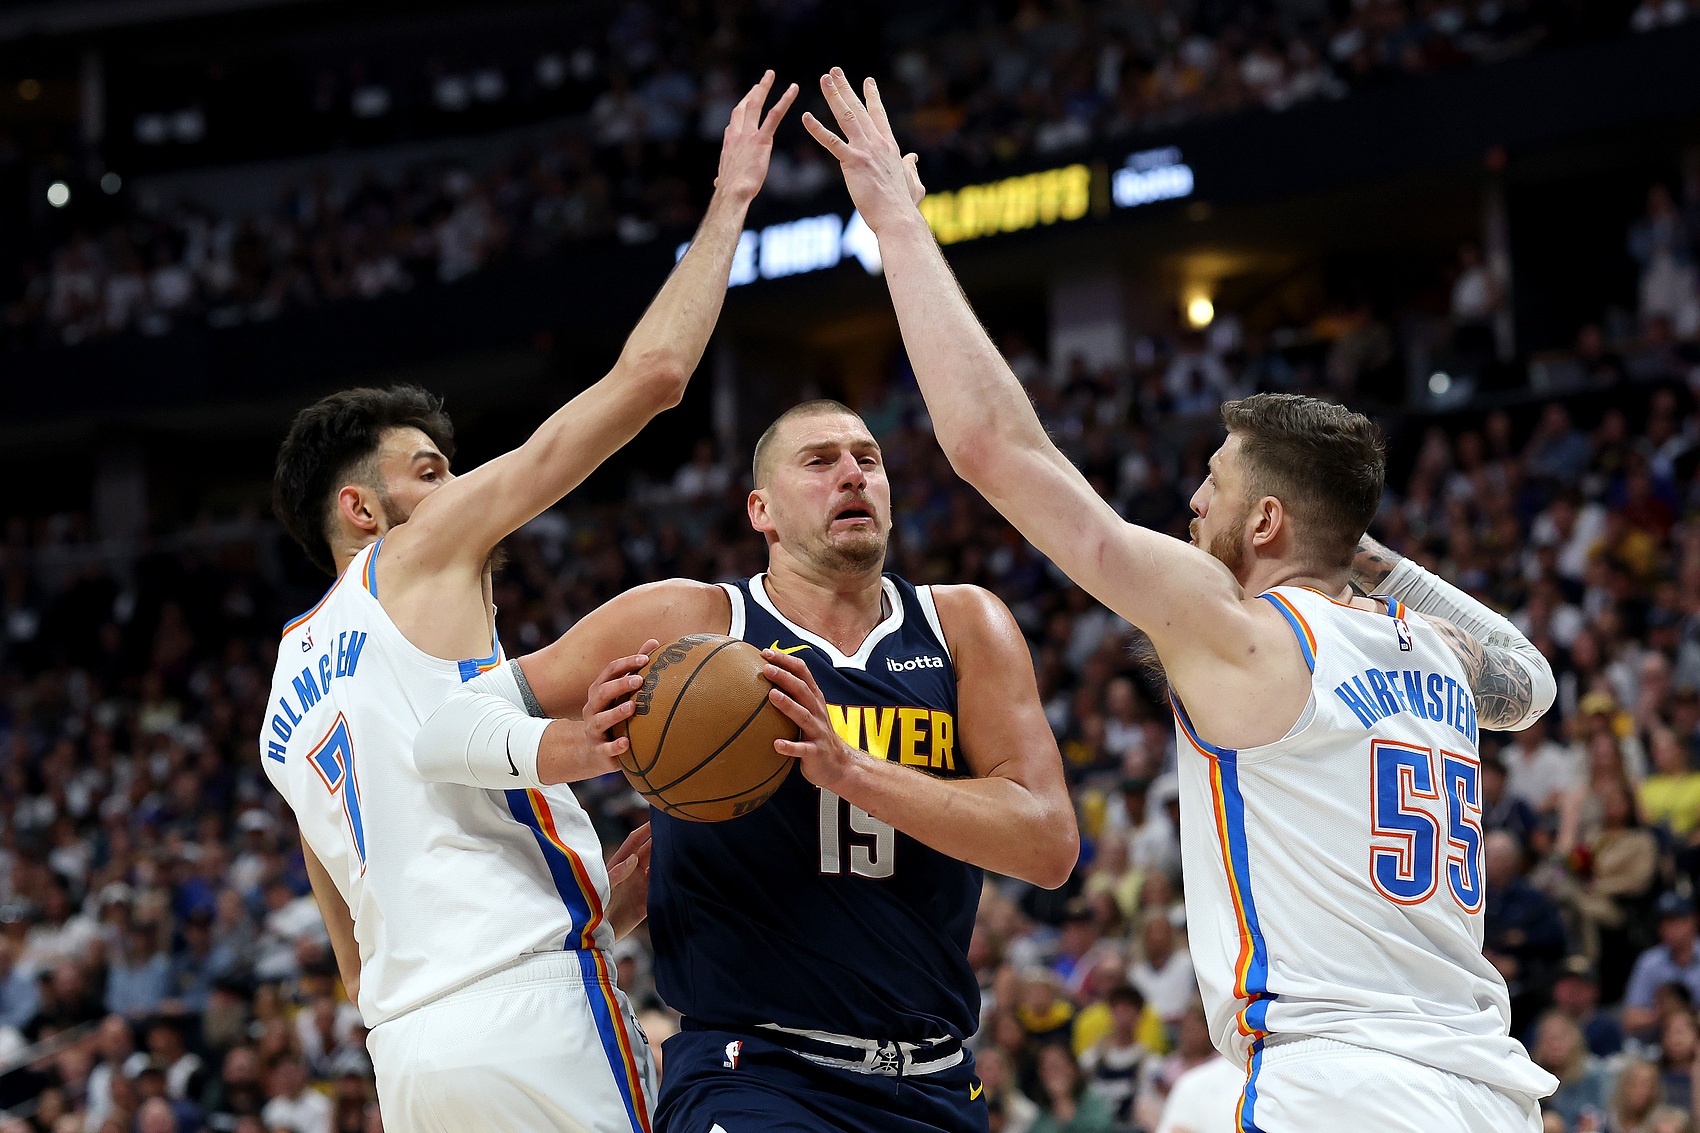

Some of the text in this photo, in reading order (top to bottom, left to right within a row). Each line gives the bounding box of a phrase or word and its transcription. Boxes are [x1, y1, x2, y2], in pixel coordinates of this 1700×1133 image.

[268, 631, 367, 764] HOLMGEN
[886, 655, 943, 673] ibotta
[1334, 668, 1477, 747] HARENSTEIN
[826, 703, 956, 770] NVER
[306, 711, 367, 878] 7
[815, 785, 896, 879] 15
[1370, 739, 1483, 915] 55
